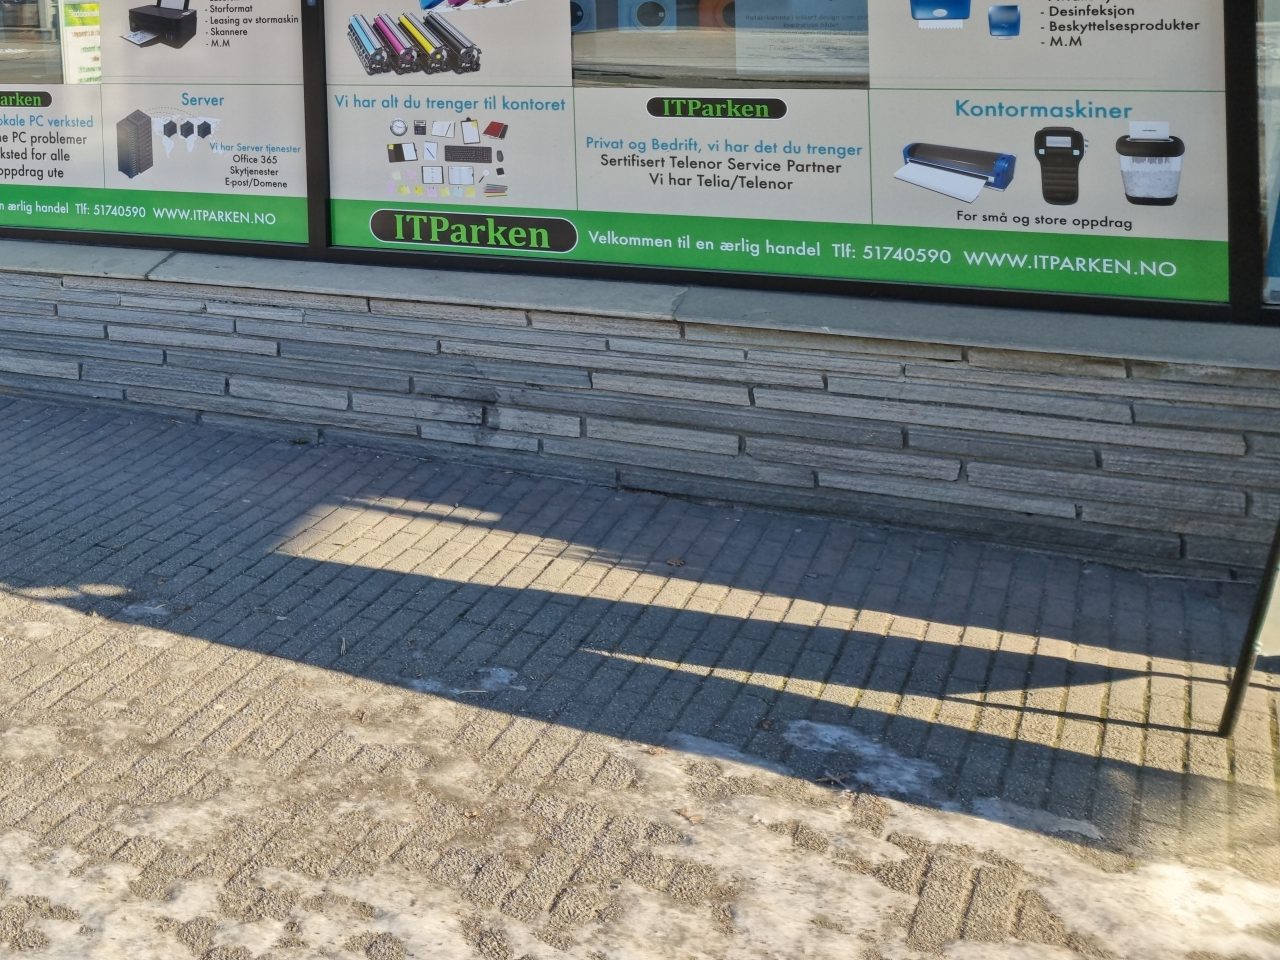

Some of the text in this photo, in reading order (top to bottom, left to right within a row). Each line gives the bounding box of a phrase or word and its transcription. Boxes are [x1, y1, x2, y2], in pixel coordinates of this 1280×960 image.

[210, 4, 253, 13] Storformat
[1049, 5, 1135, 20] Desinfeksjon
[210, 14, 299, 27] Leasing av stormaskin
[1049, 19, 1201, 35] Beskyttelsesprodukter
[210, 27, 248, 36] Skannere
[181, 93, 225, 107] Server
[334, 94, 566, 114] Vi har alt du trenger til kontoret
[662, 98, 770, 118] ITParken
[955, 98, 1133, 120] Kontormaskiner
[29, 114, 44, 128] PC
[47, 114, 95, 129] verksted
[11, 131, 27, 144] PC
[30, 132, 88, 147] problemer
[209, 142, 302, 156] Vi har Server tjenester
[586, 136, 863, 160] Privat og Bedrift, vi har det du trenger
[232, 154, 278, 165] Office 365
[600, 153, 842, 174] Sertifisert Telenor Service Partner
[230, 165, 279, 178] Skytjenester
[224, 177, 288, 190] E-post/Domene
[7, 199, 33, 215] ærlig
[35, 200, 69, 215] handel
[75, 202, 90, 216] Tlf:
[93, 204, 146, 218] 51740590
[152, 207, 276, 225] WWW.ITPARKEN.NO
[393, 214, 551, 249] ITParken
[588, 230, 1178, 278] Velkommen til en ærlig handel Tlf: 51740590 WWW.ITPARKEN.NO
